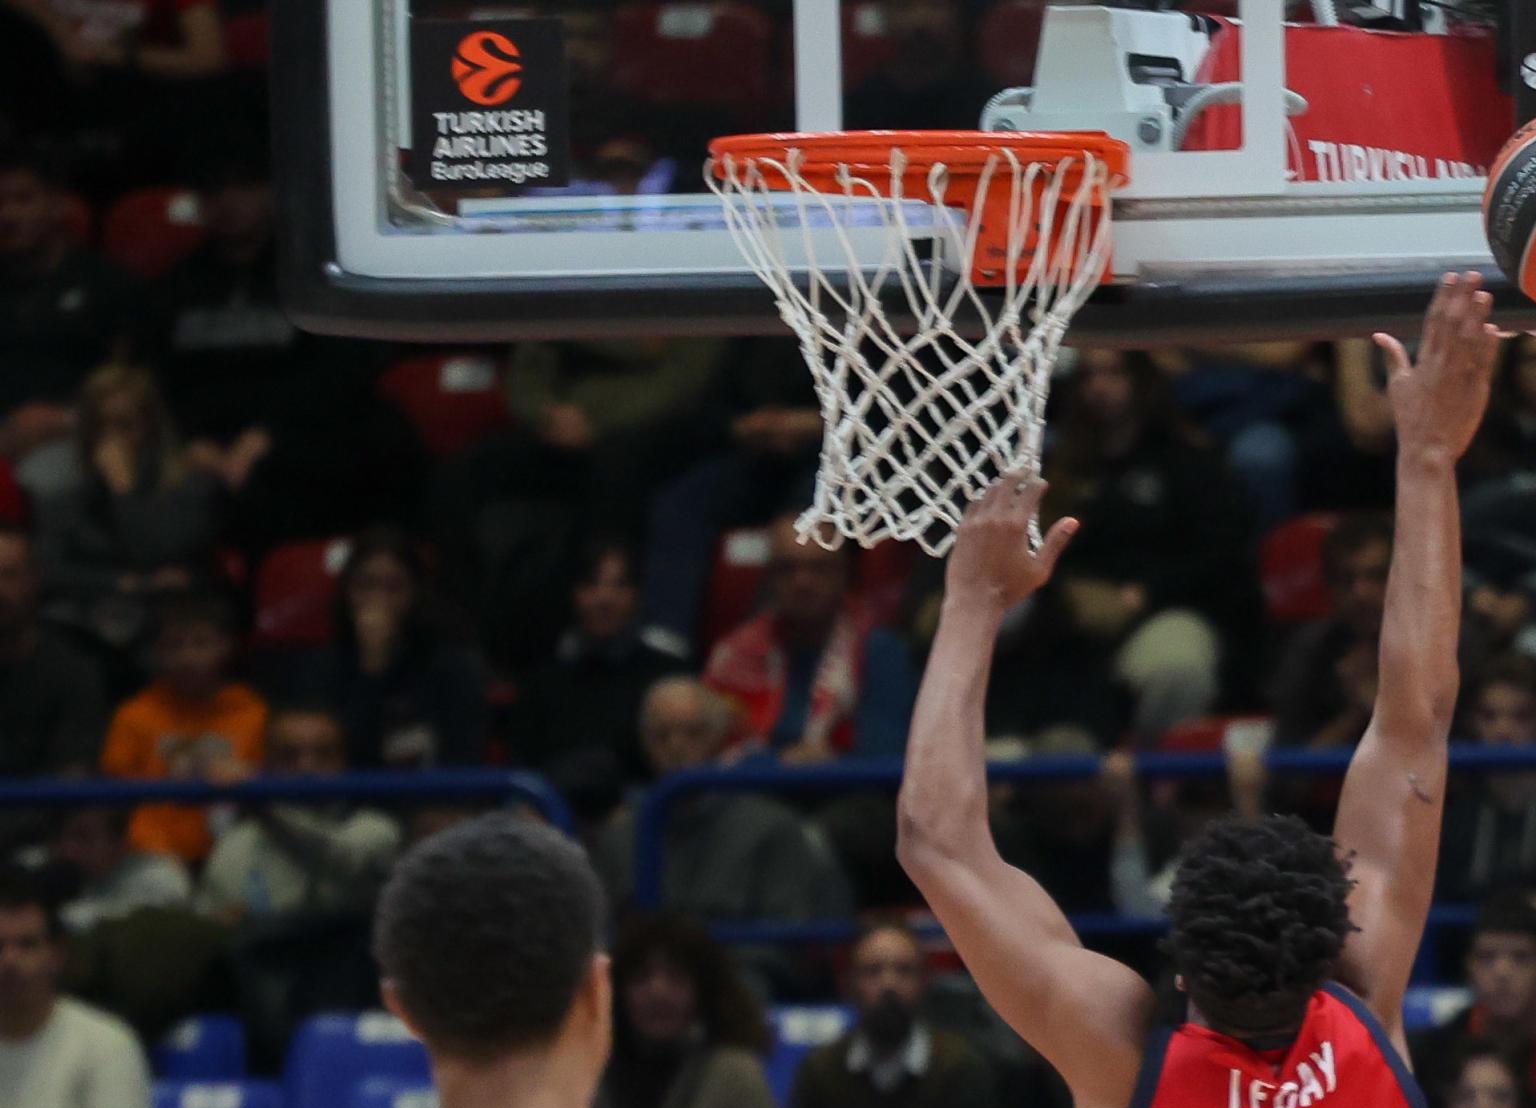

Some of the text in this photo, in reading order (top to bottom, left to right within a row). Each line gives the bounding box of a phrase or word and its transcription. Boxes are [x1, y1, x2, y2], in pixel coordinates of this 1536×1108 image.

[432, 110, 545, 134] TURKISH
[432, 133, 548, 158] AIRLINES
[430, 160, 549, 184] EuroLeague
